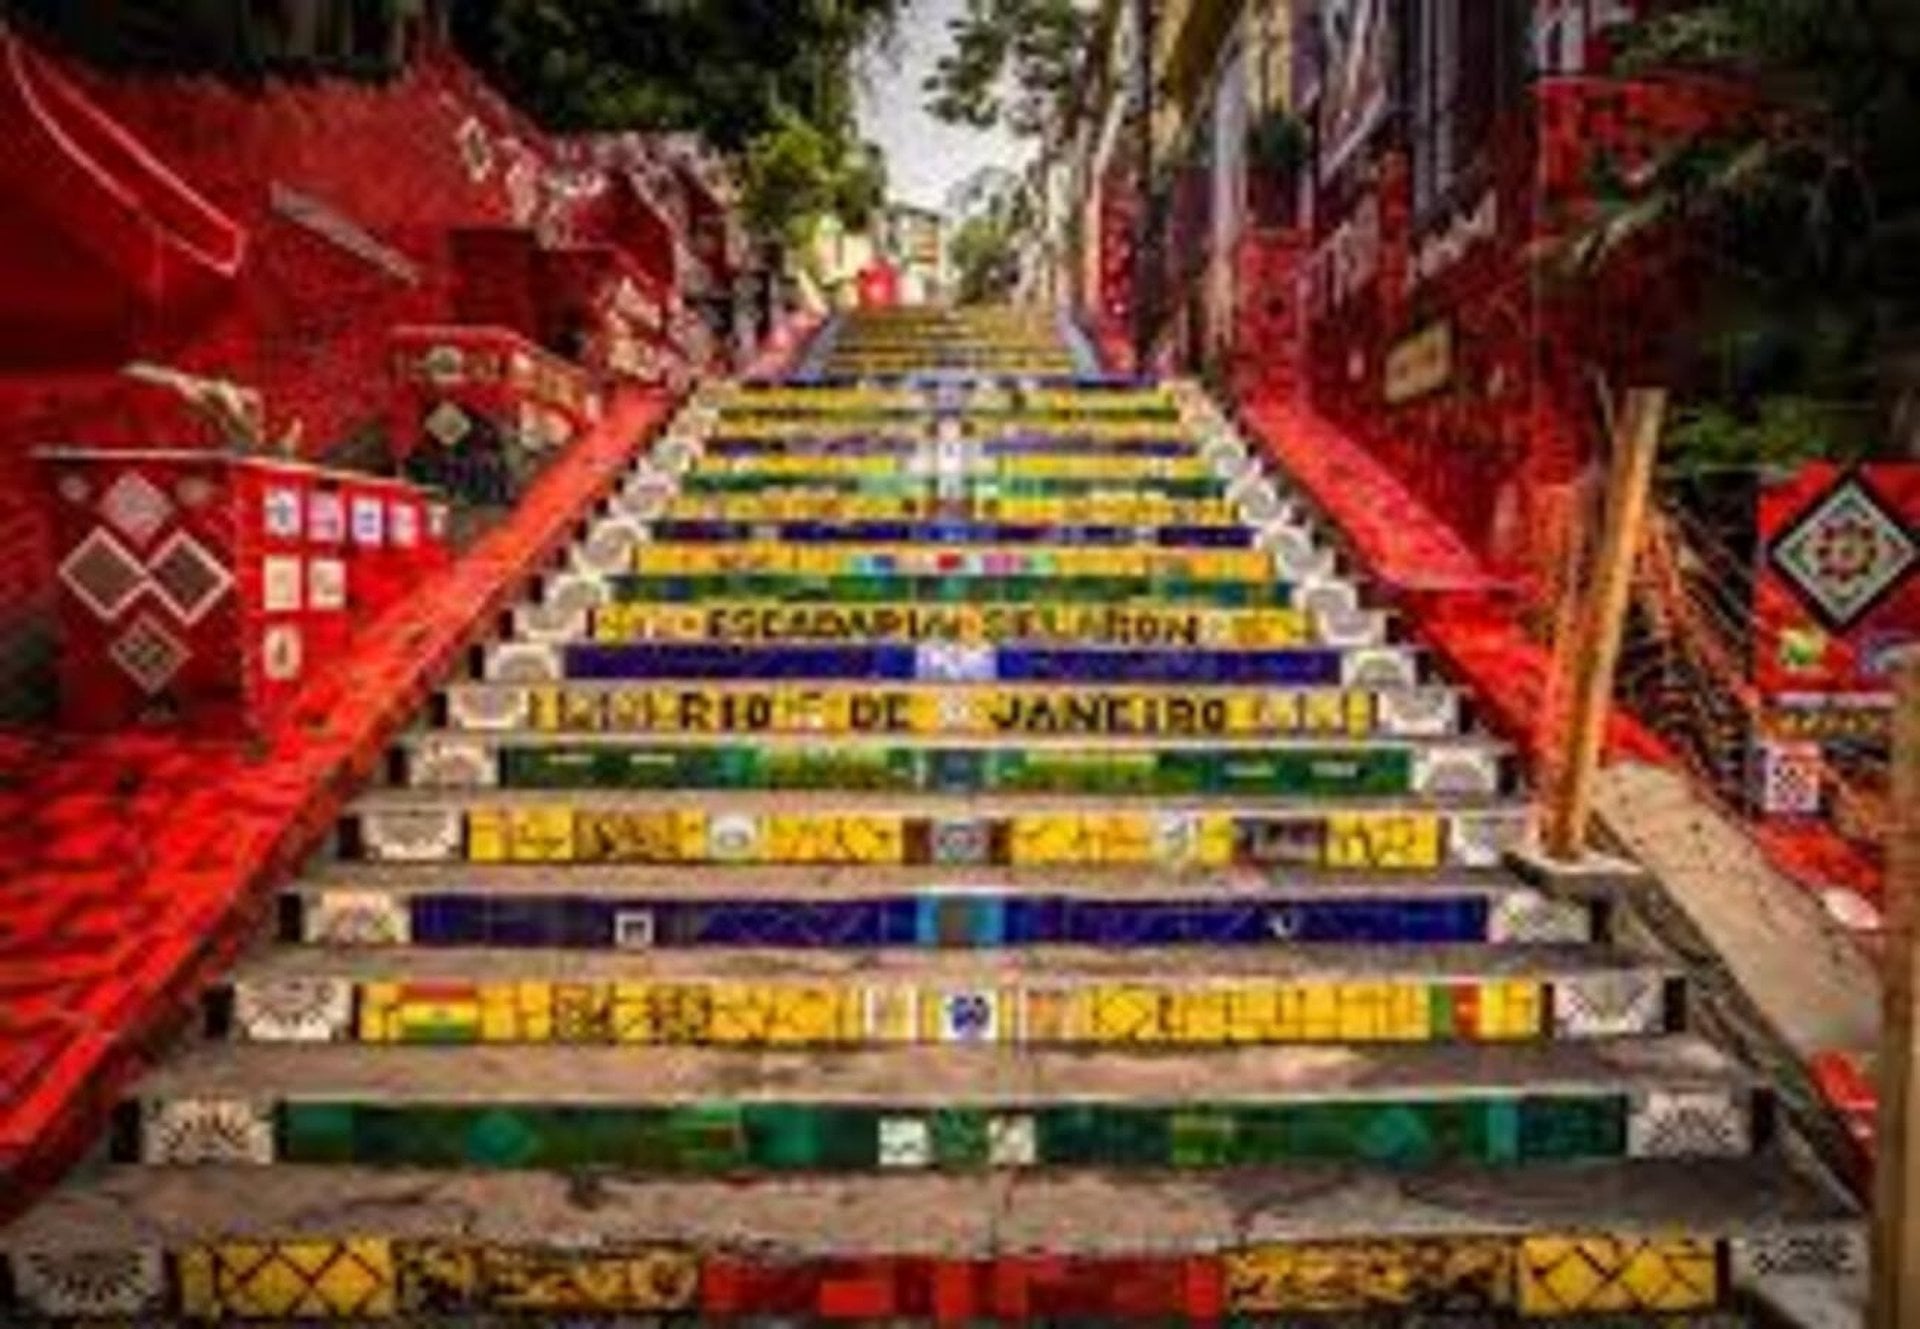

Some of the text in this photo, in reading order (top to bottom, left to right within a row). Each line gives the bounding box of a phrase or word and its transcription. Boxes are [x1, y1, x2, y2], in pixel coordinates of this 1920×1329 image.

[680, 691, 1226, 734] RIO DE JANEIRO
